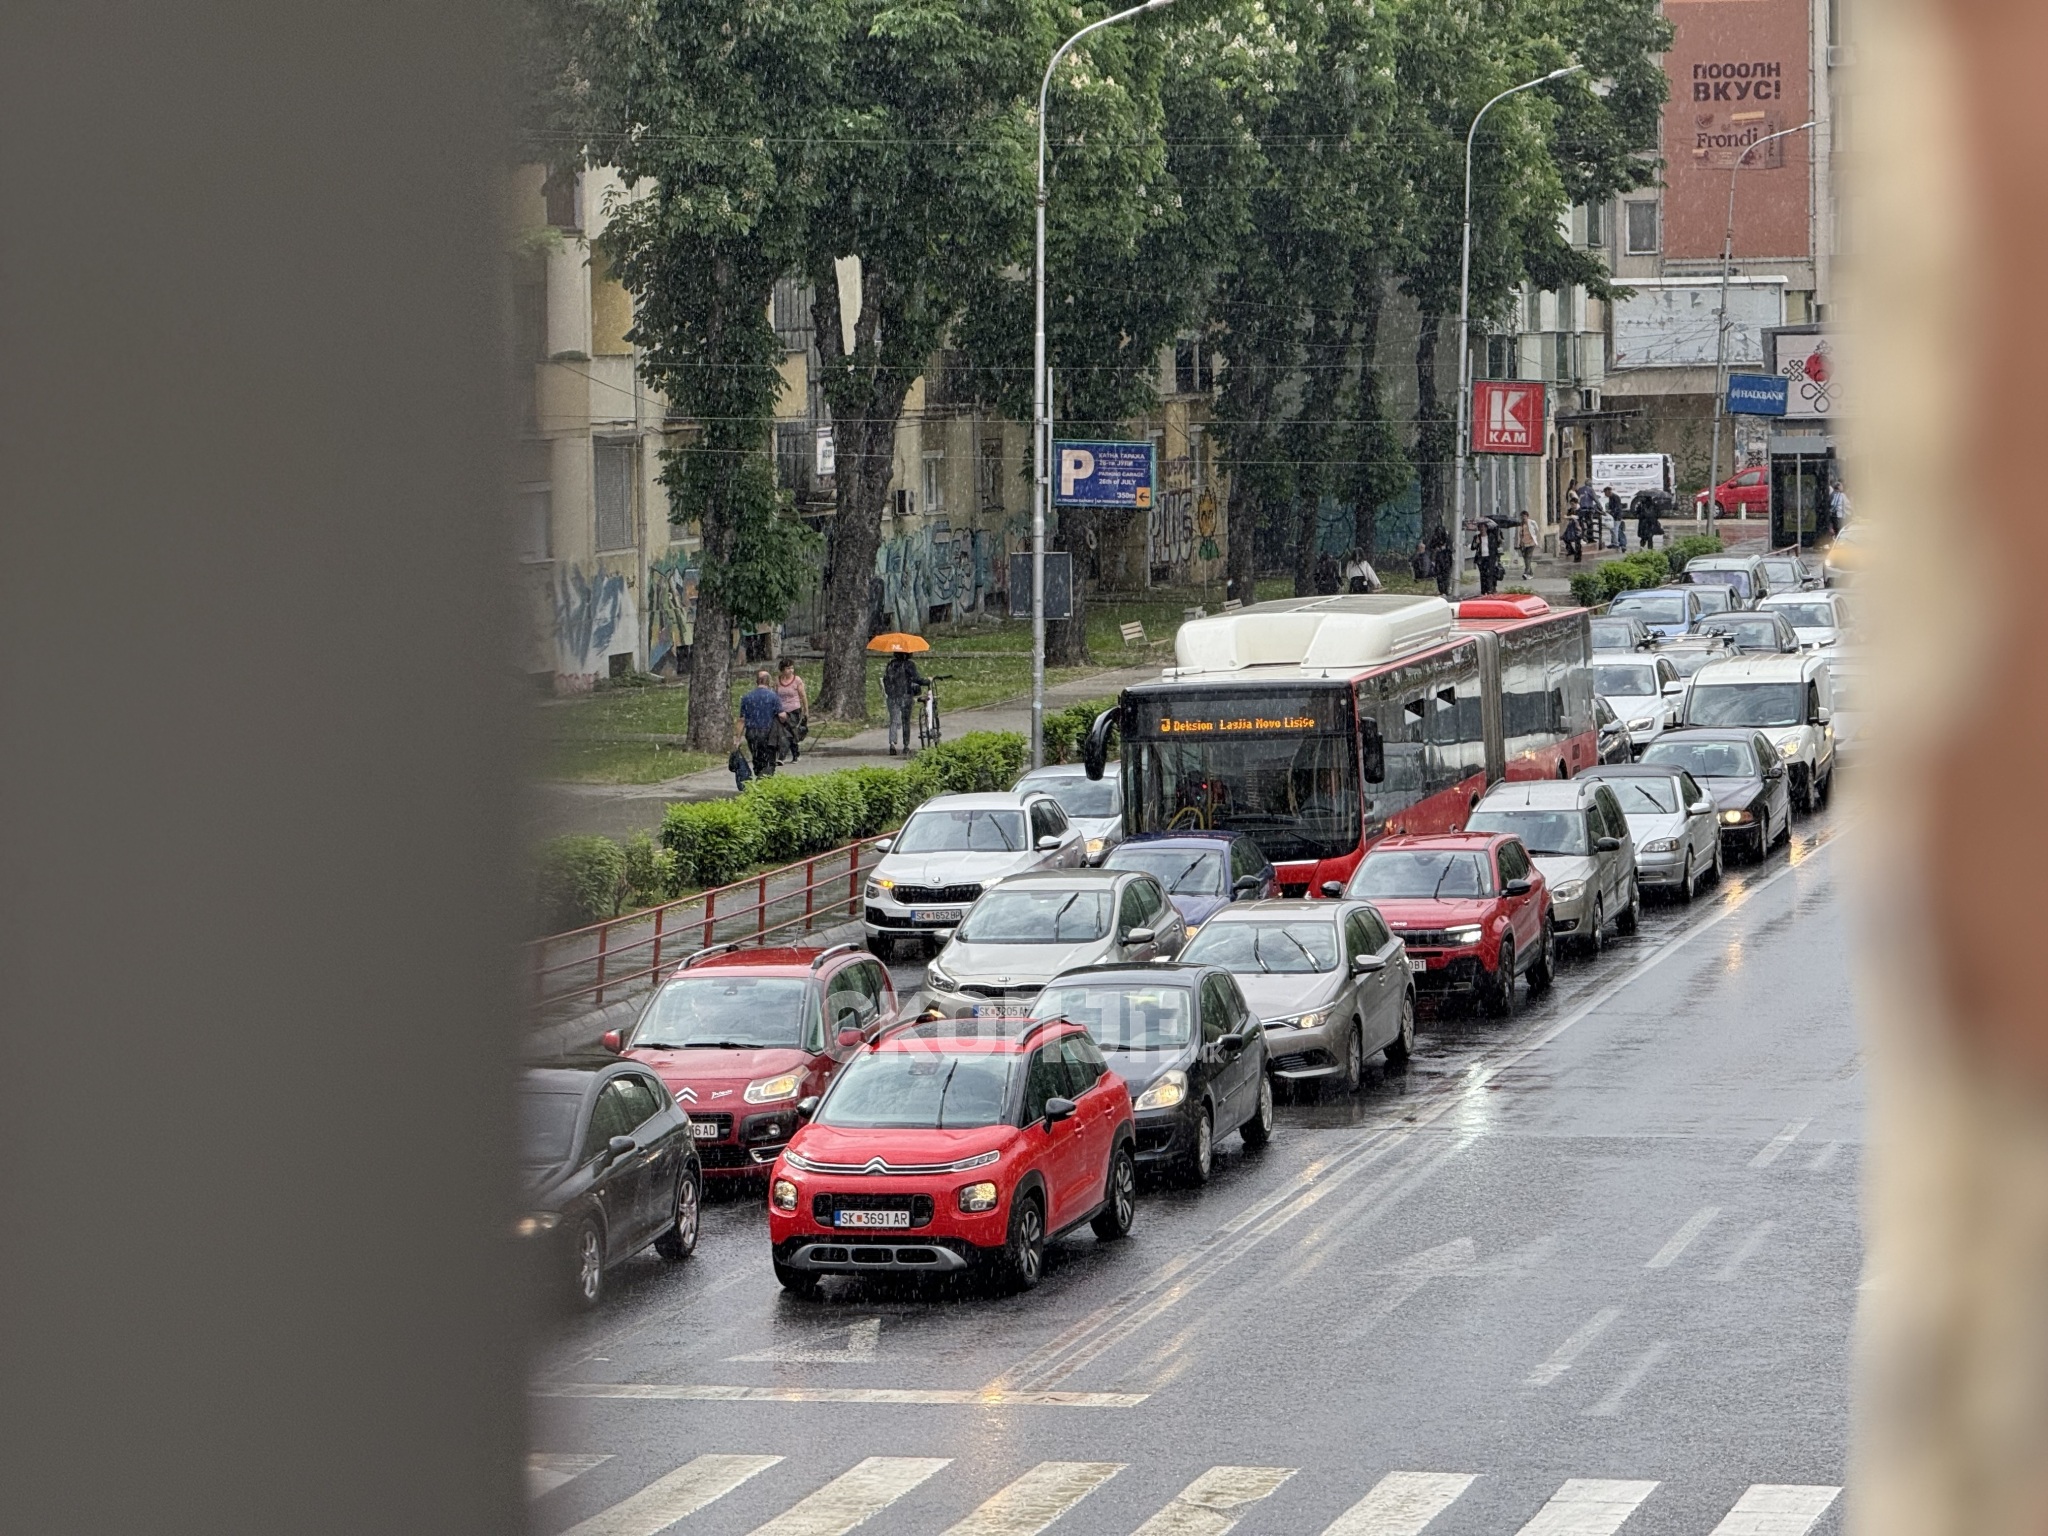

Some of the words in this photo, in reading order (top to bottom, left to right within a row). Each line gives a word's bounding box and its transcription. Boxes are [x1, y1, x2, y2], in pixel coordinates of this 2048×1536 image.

[1693, 62, 1781, 79] ПОООЛН
[1693, 80, 1781, 102] ВКУС!
[1696, 127, 1758, 148] Frondi
[1741, 389, 1785, 401] HALKBANK
[1061, 449, 1095, 496] P
[1255, 717, 1281, 729] Novo
[916, 912, 925, 920] SK
[931, 911, 950, 920] 1652
[979, 1006, 990, 1016] SK
[702, 1124, 716, 1136] AD
[841, 1212, 855, 1225] SK
[862, 1212, 890, 1225] 3691
[893, 1212, 908, 1225] AR
